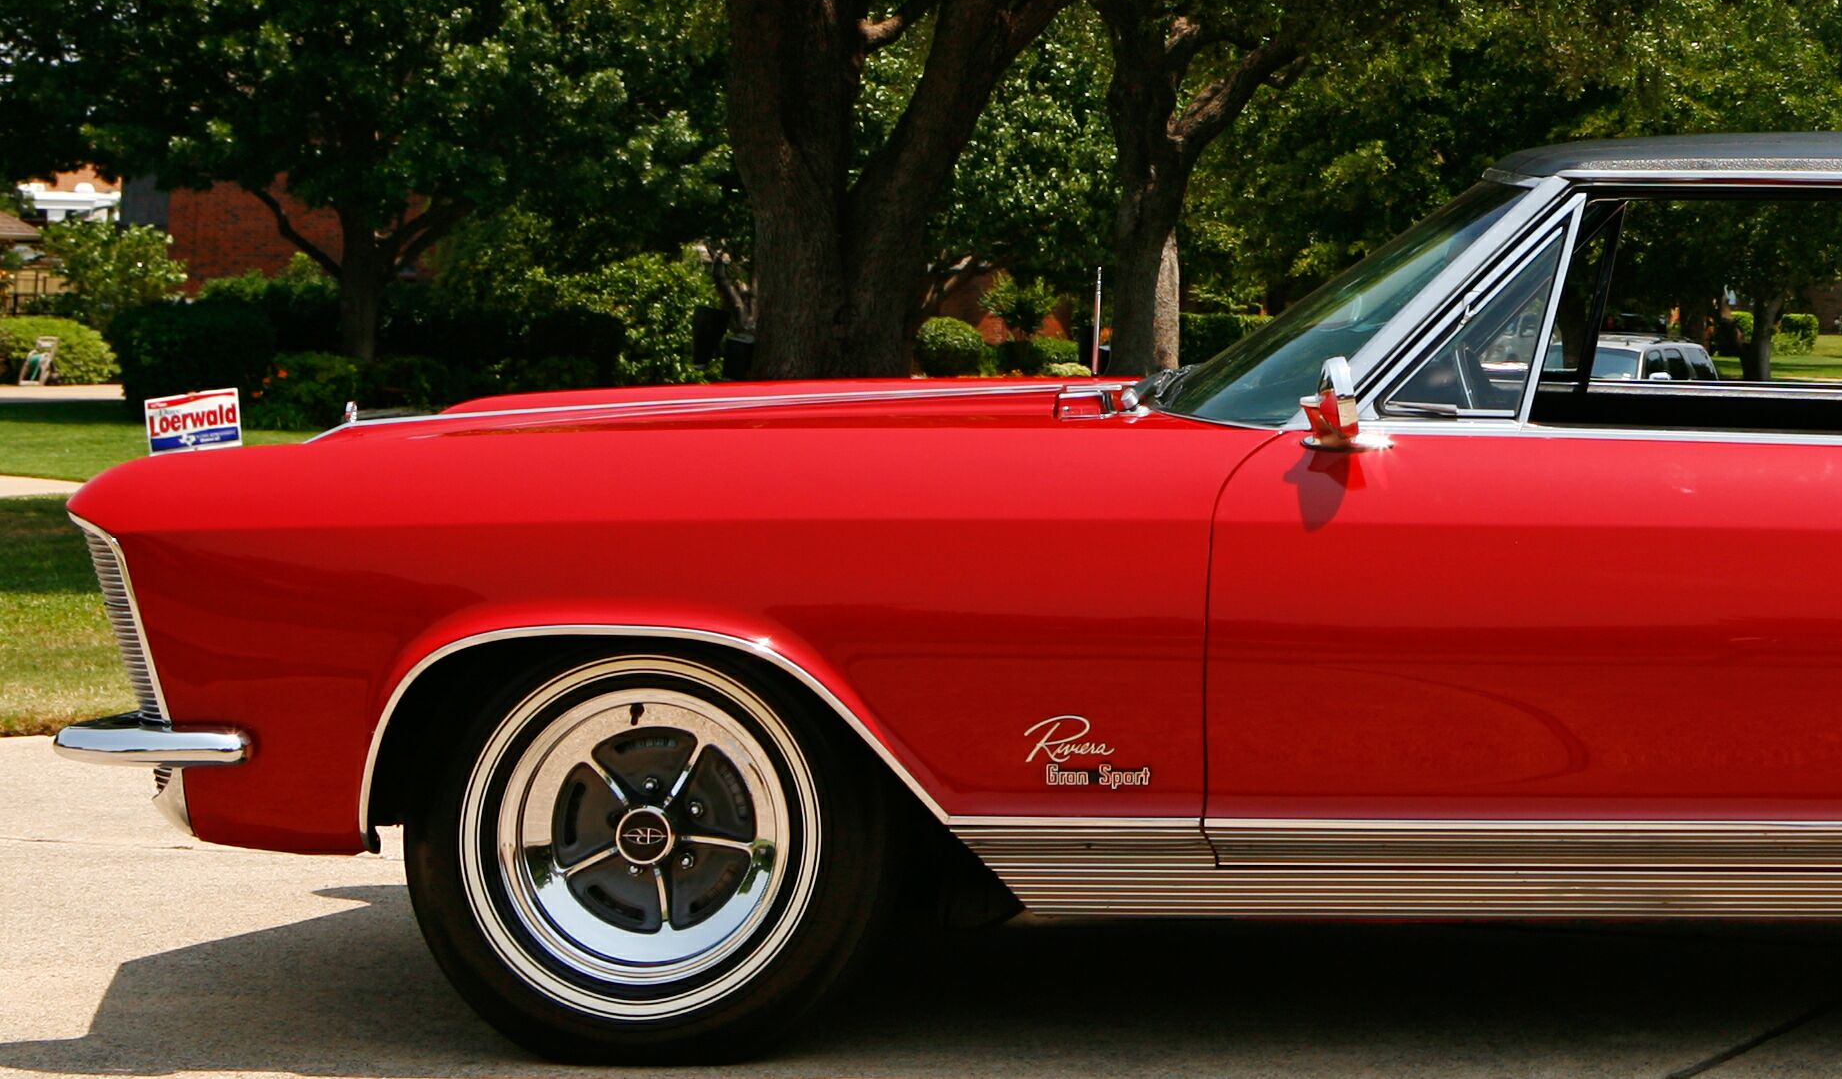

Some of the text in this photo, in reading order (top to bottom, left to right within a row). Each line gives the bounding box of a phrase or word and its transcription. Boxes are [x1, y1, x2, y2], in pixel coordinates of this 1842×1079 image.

[149, 403, 237, 437] Loerwald
[1023, 715, 1115, 762] Riviera
[1046, 763, 1150, 789] Gran Sport
